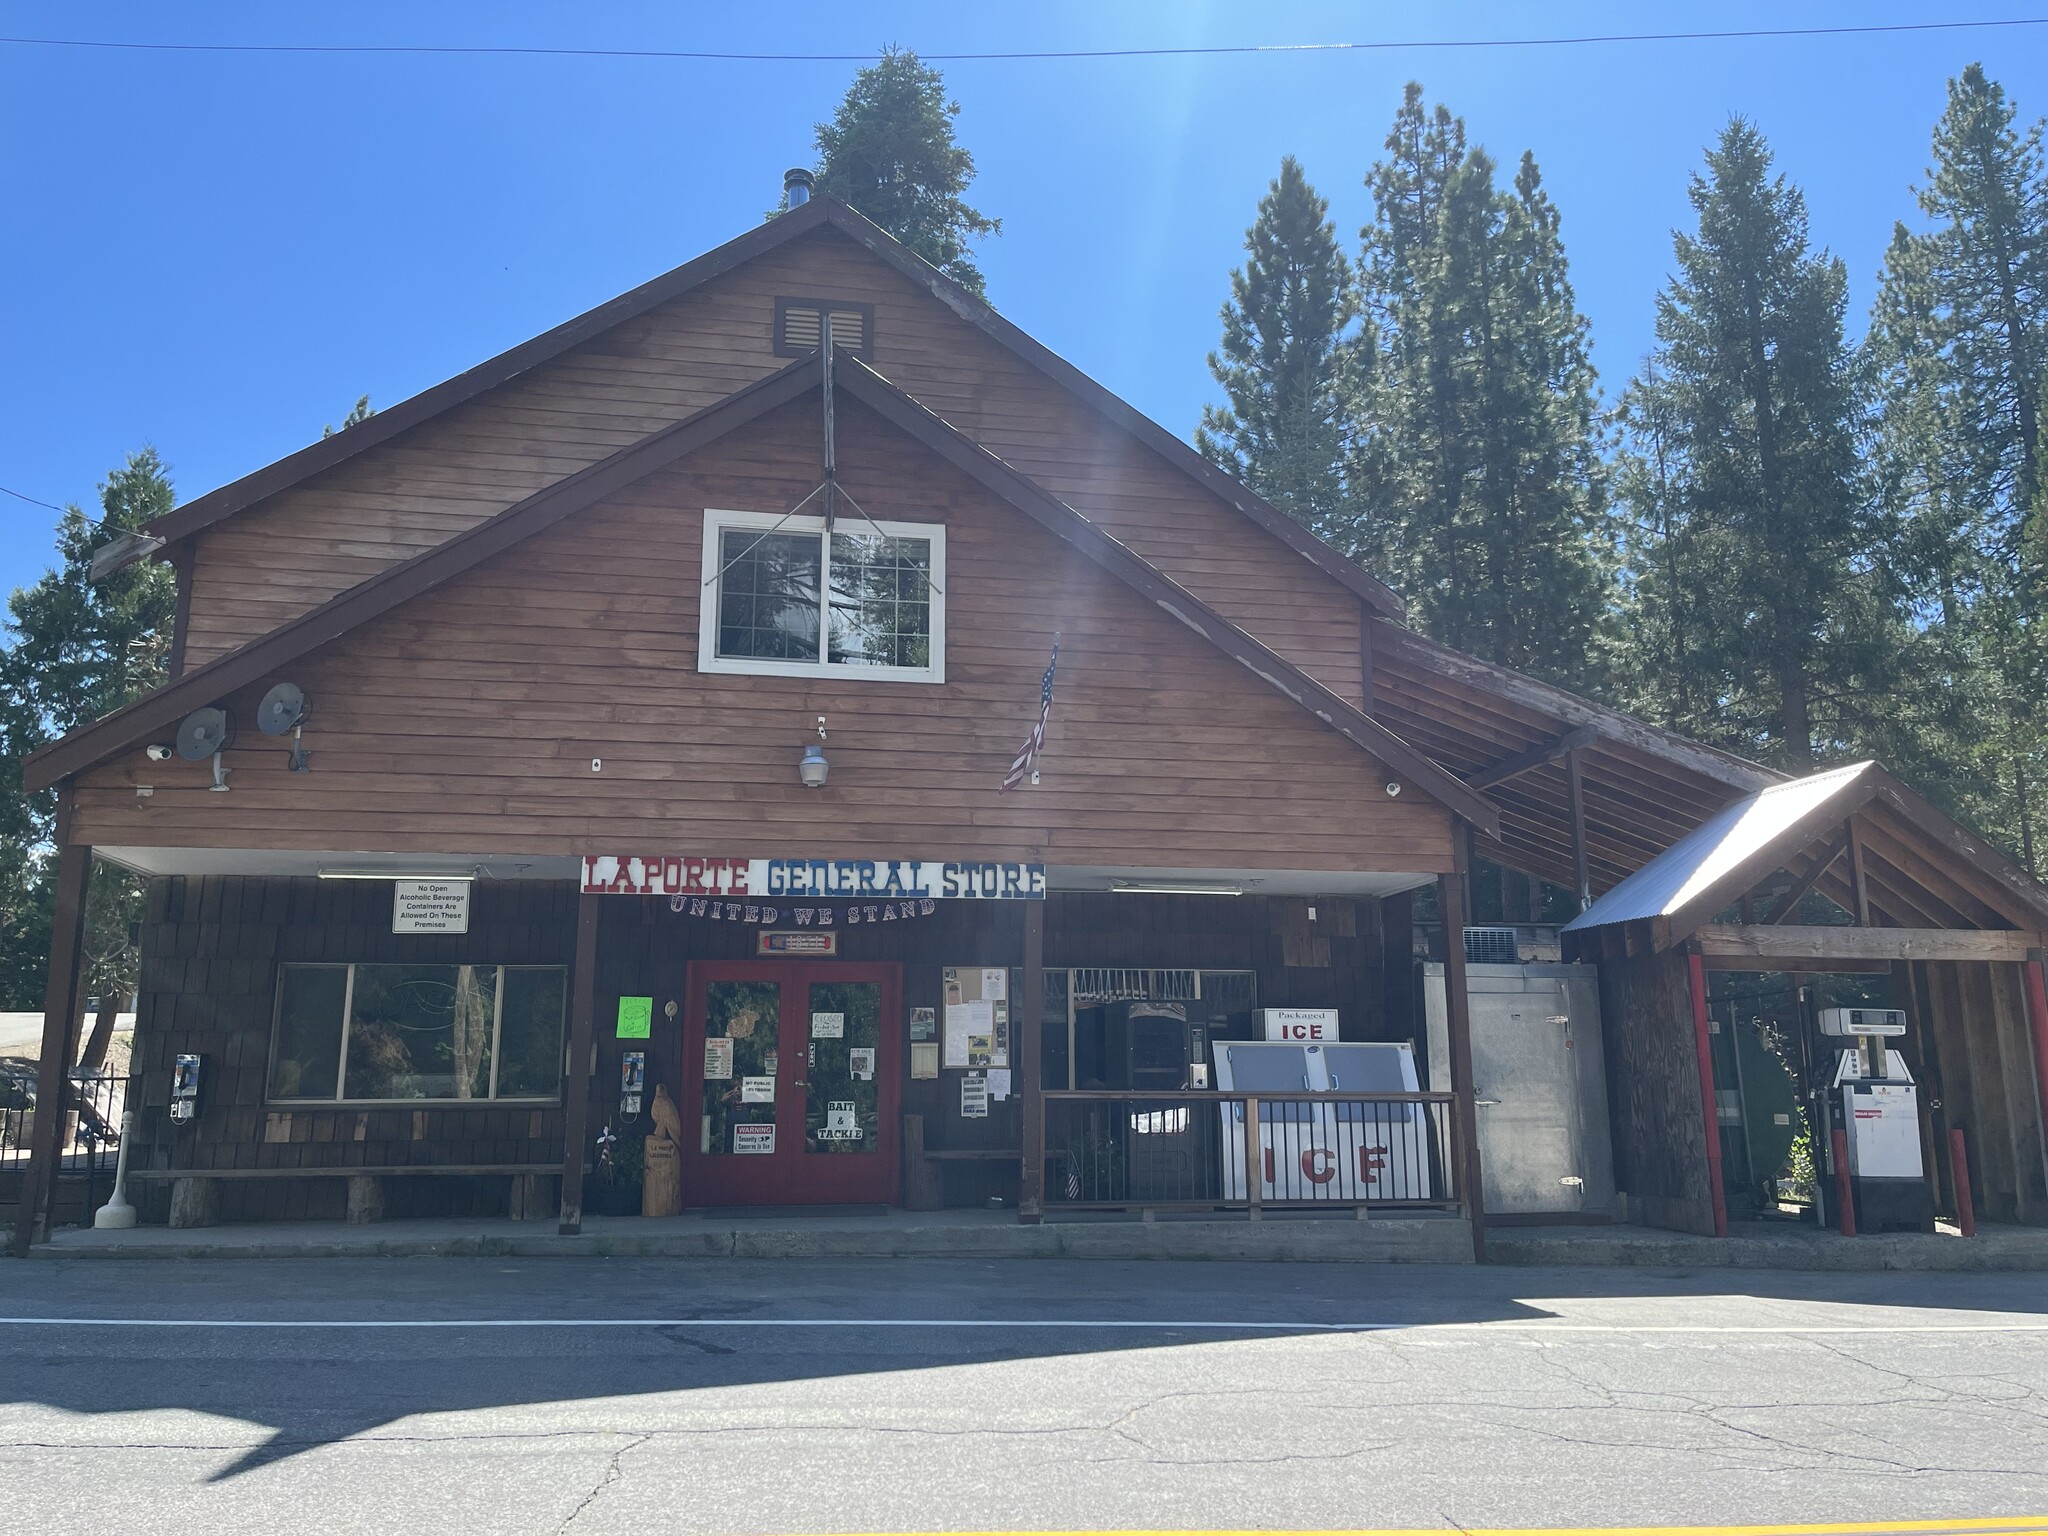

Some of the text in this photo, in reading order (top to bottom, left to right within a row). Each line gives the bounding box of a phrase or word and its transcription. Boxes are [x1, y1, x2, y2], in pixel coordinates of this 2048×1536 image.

[584, 855, 1045, 899] LAPORTE GENERAL STORE
[429, 885, 448, 893] Open
[432, 894, 465, 902] Beverage
[670, 894, 936, 926] UNITED WE STAND
[1278, 1011, 1326, 1021] Packaged
[1282, 1024, 1324, 1040] ICE
[828, 1102, 854, 1111] BAIT
[837, 1116, 844, 1125] &
[738, 1126, 772, 1134] WARNING
[818, 1129, 862, 1139] TACKLE
[738, 1135, 757, 1144] Security
[1264, 1141, 1388, 1184] ICE
